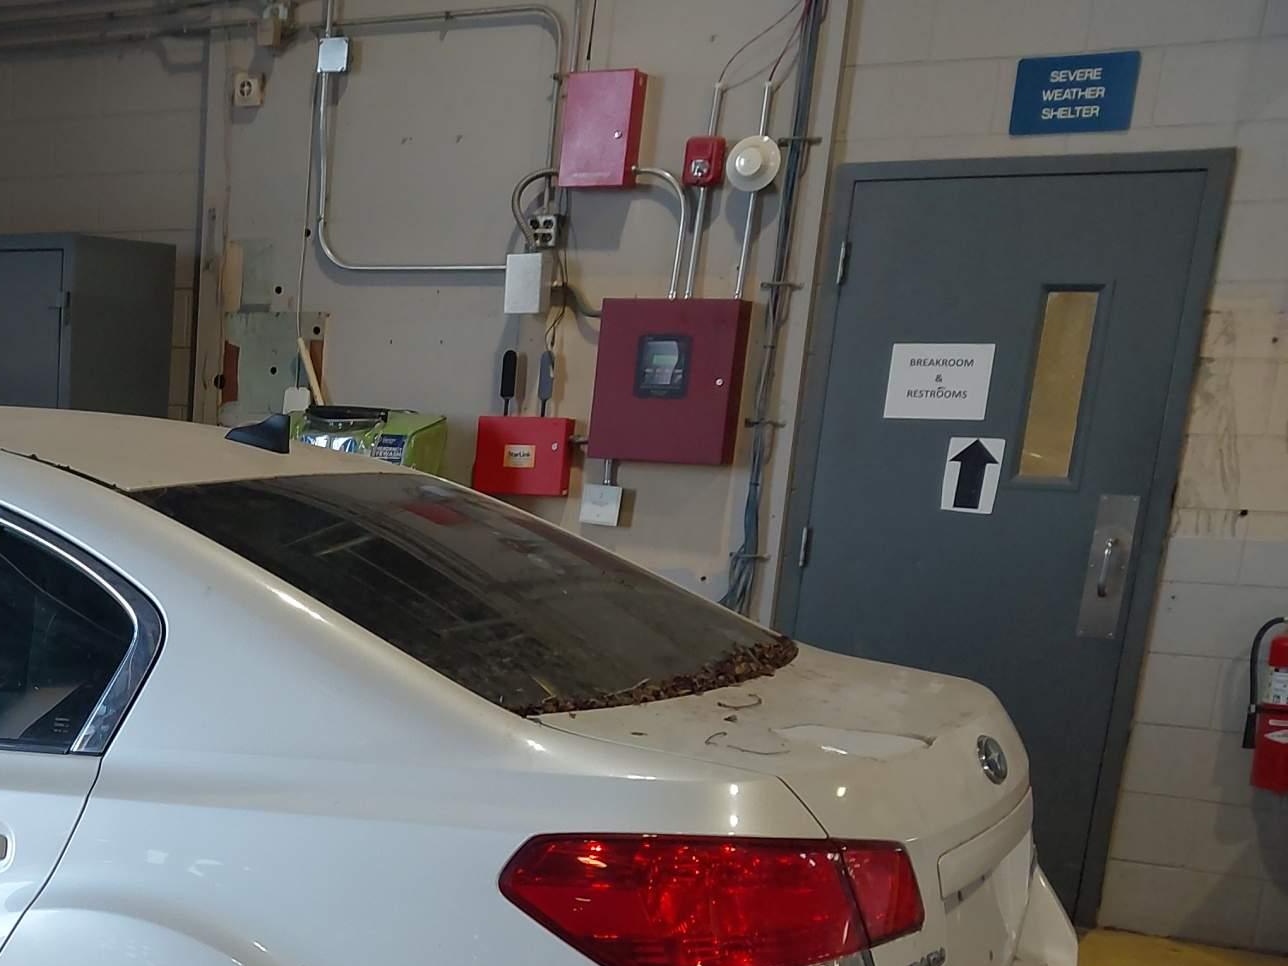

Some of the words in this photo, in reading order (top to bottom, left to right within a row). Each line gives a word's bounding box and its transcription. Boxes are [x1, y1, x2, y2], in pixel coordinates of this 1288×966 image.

[1050, 67, 1103, 83] SEVERE
[1041, 86, 1106, 102] WEATHER
[1040, 105, 1100, 120] SHELTER
[909, 358, 974, 368] BREAKROOM
[934, 374, 943, 383] &
[906, 389, 968, 399] RESTROOMS
